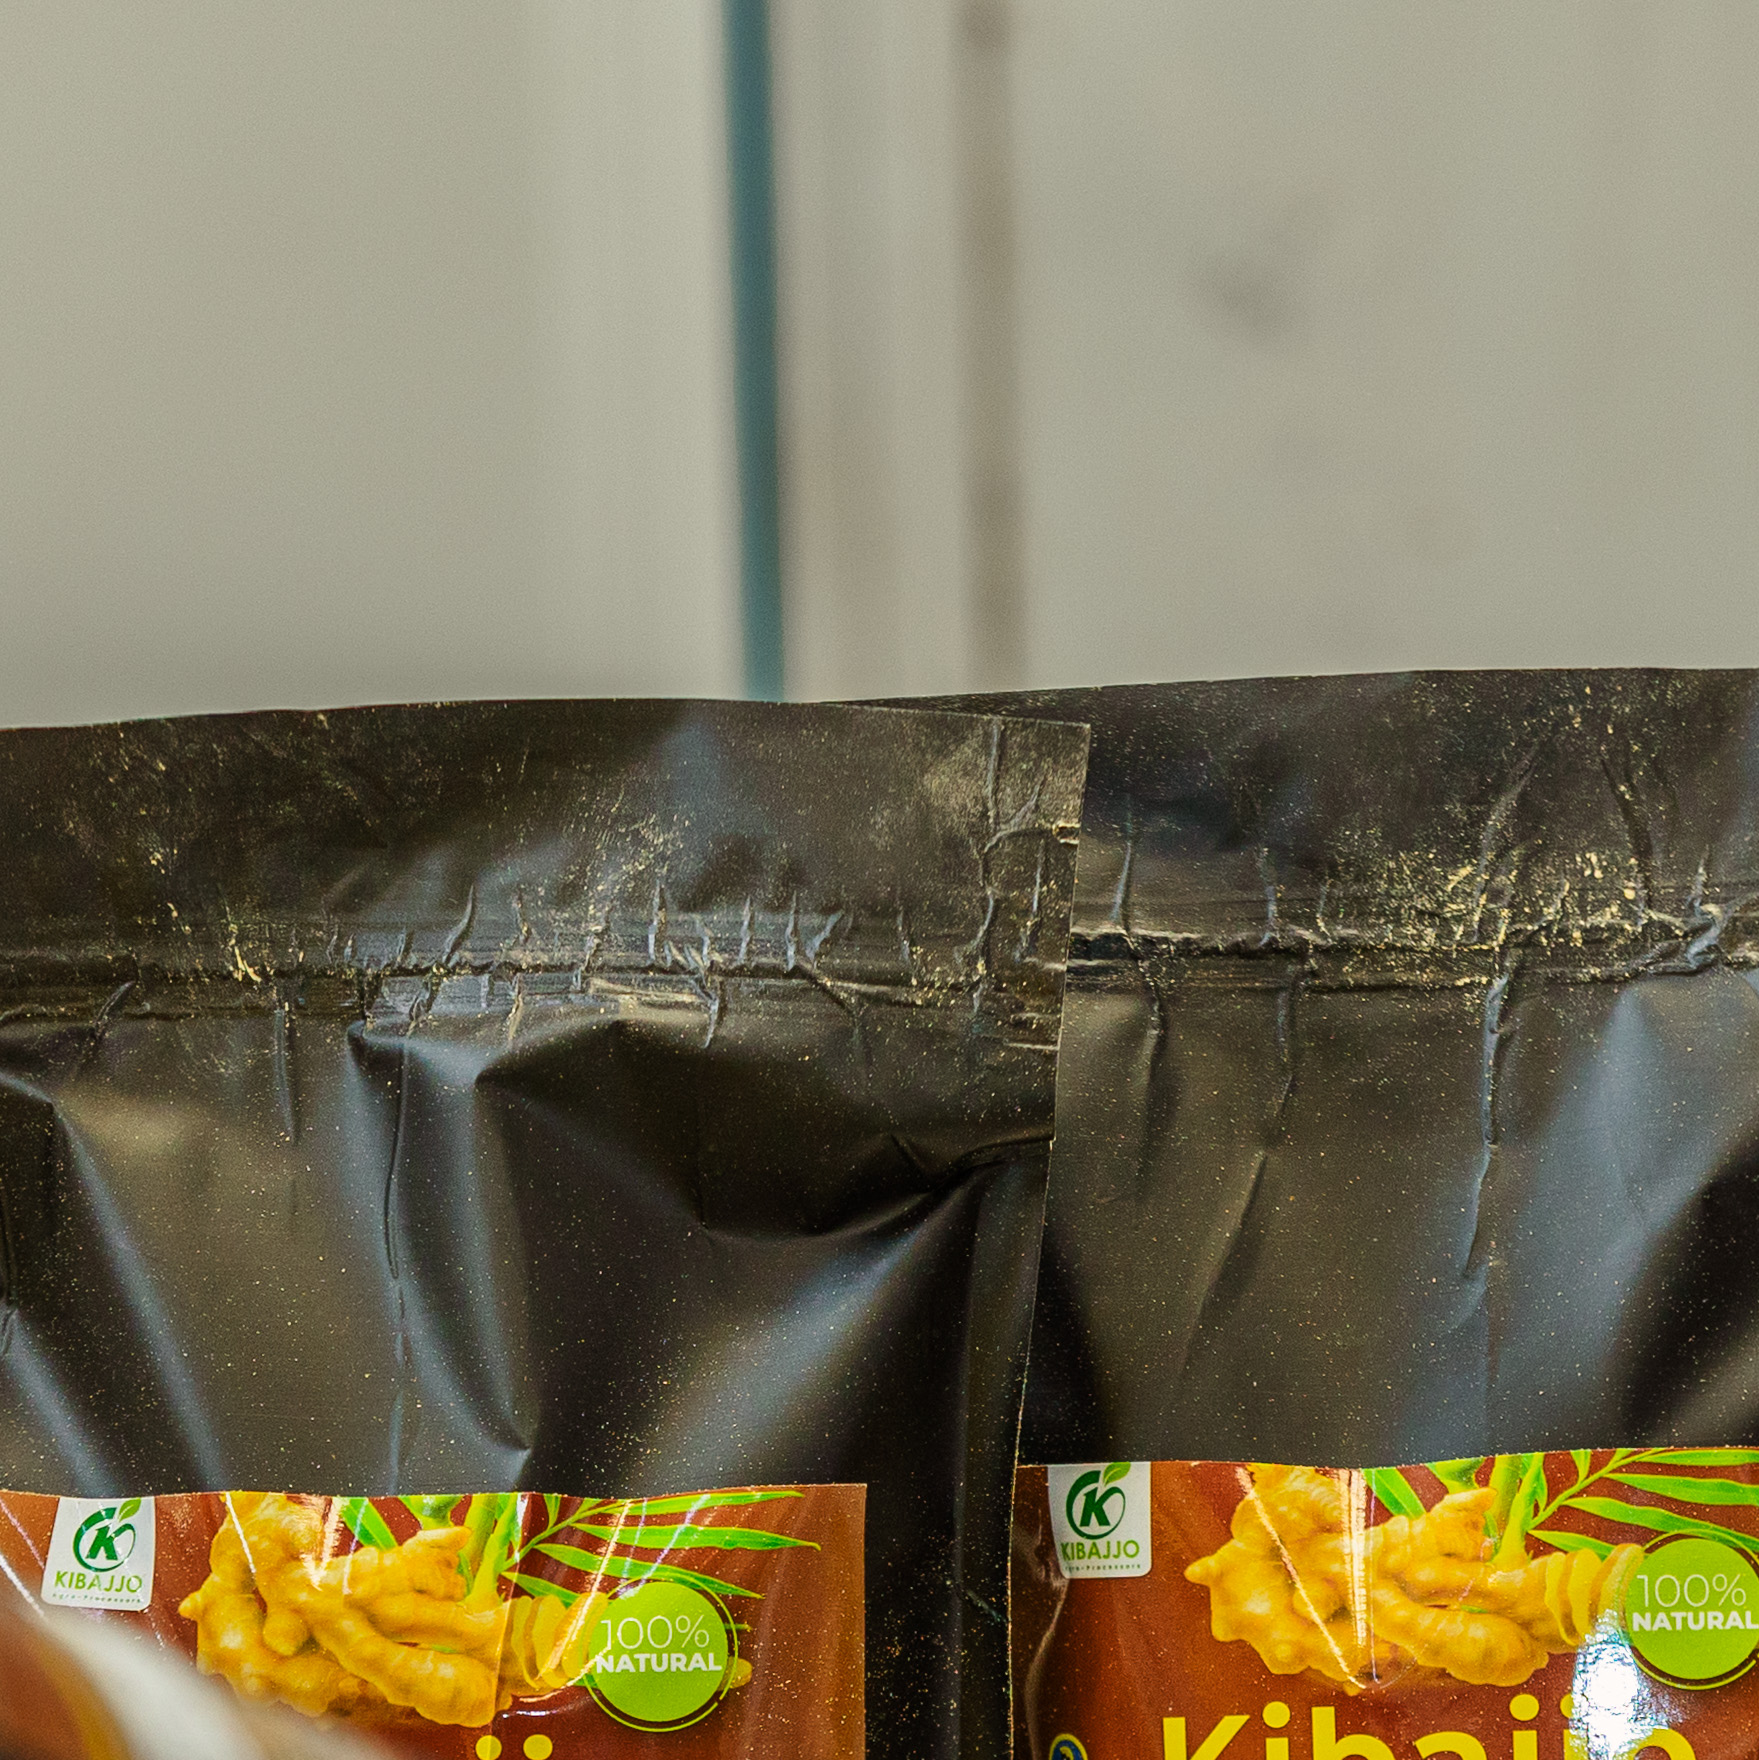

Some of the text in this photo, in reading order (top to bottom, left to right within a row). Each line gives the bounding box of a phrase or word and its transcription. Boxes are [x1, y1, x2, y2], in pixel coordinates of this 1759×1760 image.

[1061, 1540, 1139, 1561] KIBAJJO
[55, 1571, 142, 1593] KIBAJJO
[1636, 1574, 1747, 1608] 100%
[1632, 1611, 1759, 1632] NATURAL
[601, 1615, 709, 1650] 100%
[596, 1653, 722, 1674] NATURAL
